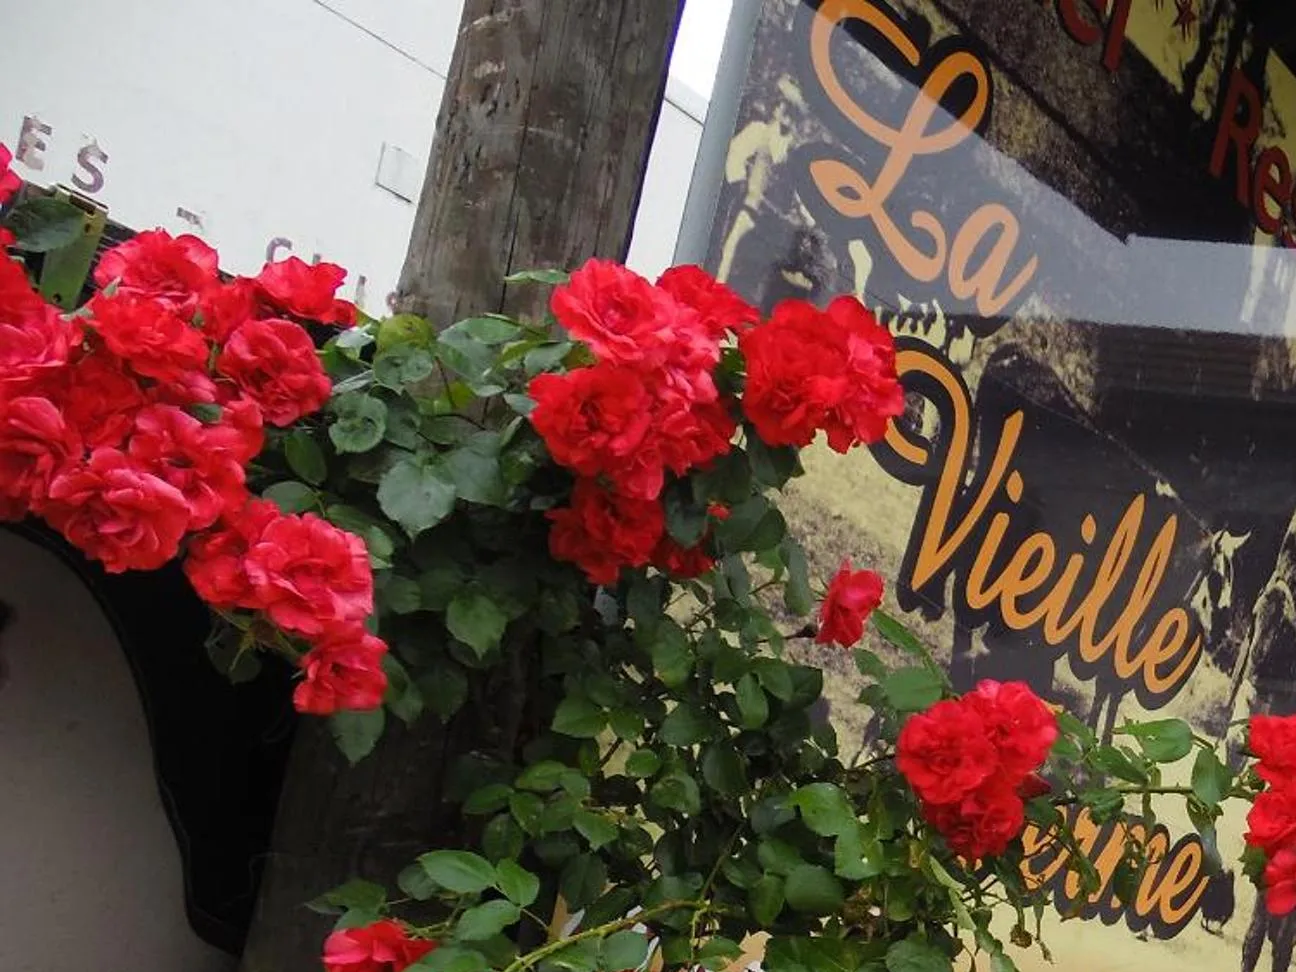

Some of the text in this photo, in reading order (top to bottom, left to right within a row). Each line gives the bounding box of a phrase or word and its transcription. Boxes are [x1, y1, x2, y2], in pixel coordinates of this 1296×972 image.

[809, 0, 1039, 318] La
[884, 349, 1203, 695] Vieille
[955, 803, 1209, 925] erme
